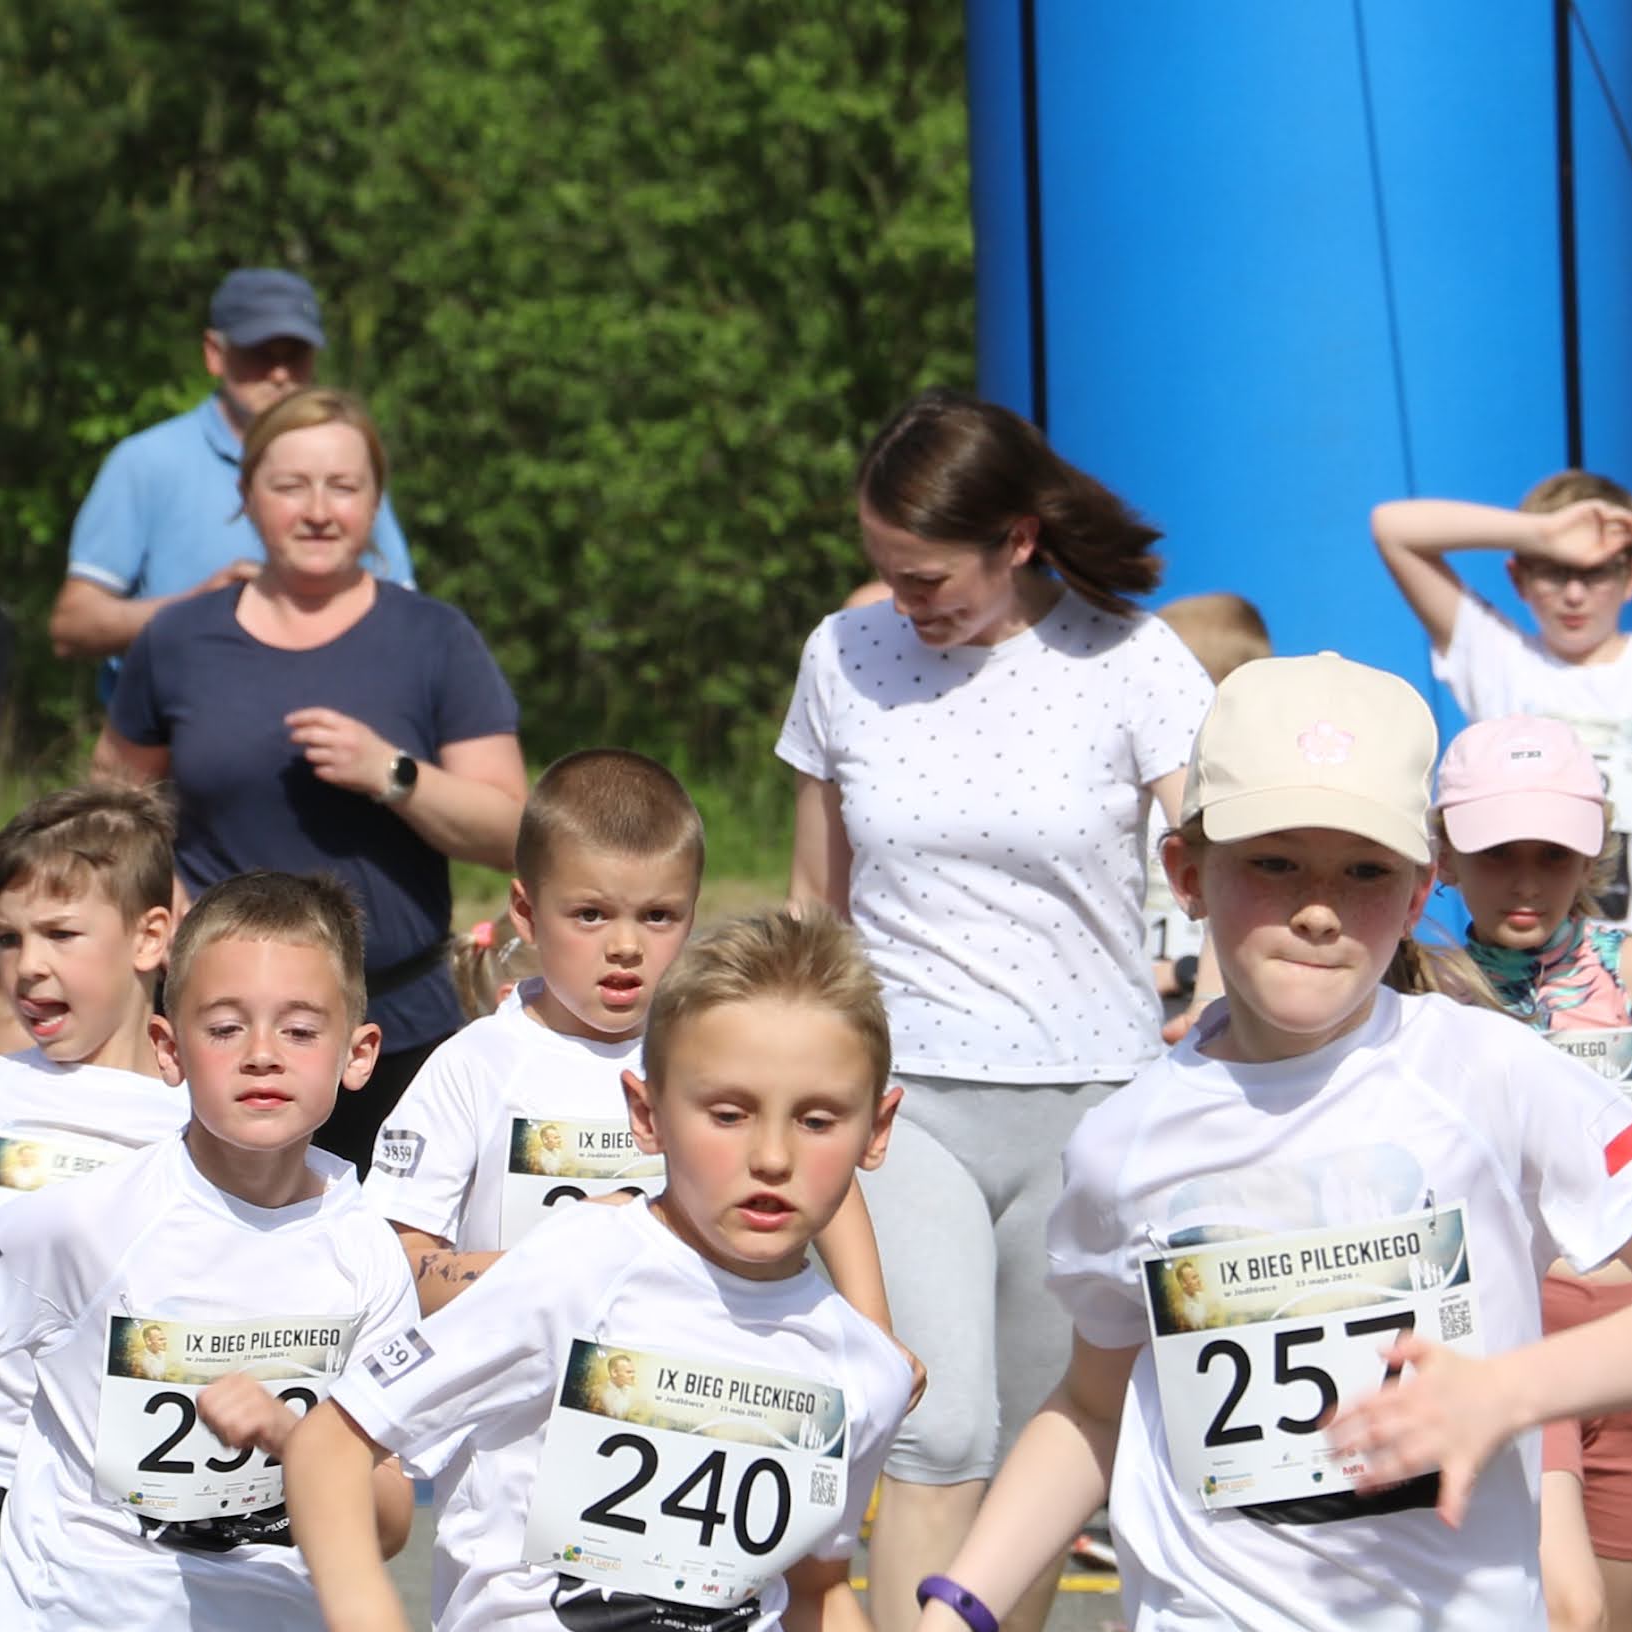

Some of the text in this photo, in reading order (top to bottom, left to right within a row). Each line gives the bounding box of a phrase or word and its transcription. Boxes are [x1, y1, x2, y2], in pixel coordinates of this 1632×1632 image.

[579, 1132, 633, 1149] IX BIEG
[1219, 1232, 1420, 1285] IX BIEG PILECKIEGO
[186, 1329, 341, 1353] IX BIEG PILECKIEGO
[657, 1368, 816, 1415] IX BIEG PILECKIEGO
[1196, 1311, 1416, 1447] 257
[580, 1432, 791, 1556] 240
